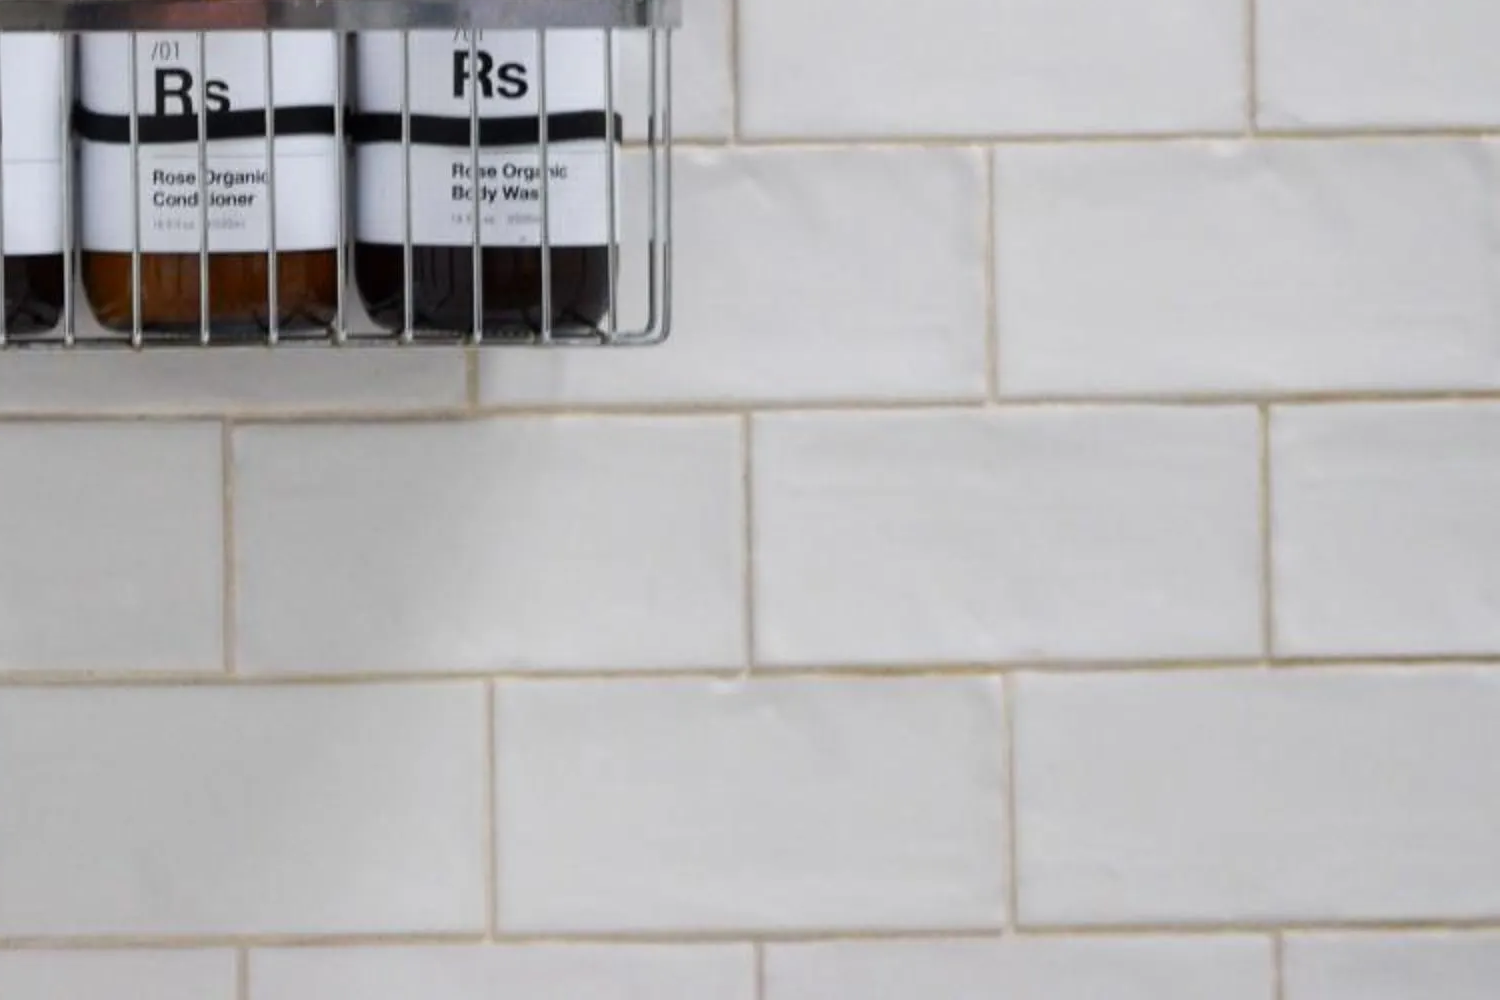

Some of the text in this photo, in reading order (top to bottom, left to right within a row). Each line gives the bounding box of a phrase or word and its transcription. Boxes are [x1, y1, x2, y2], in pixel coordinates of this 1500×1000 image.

[150, 40, 180, 61] /01
[453, 49, 529, 99] Rs
[155, 67, 231, 116] Rs
[153, 168, 197, 186] Rose
[153, 190, 256, 208] Condioner
[502, 184, 544, 201] Was
